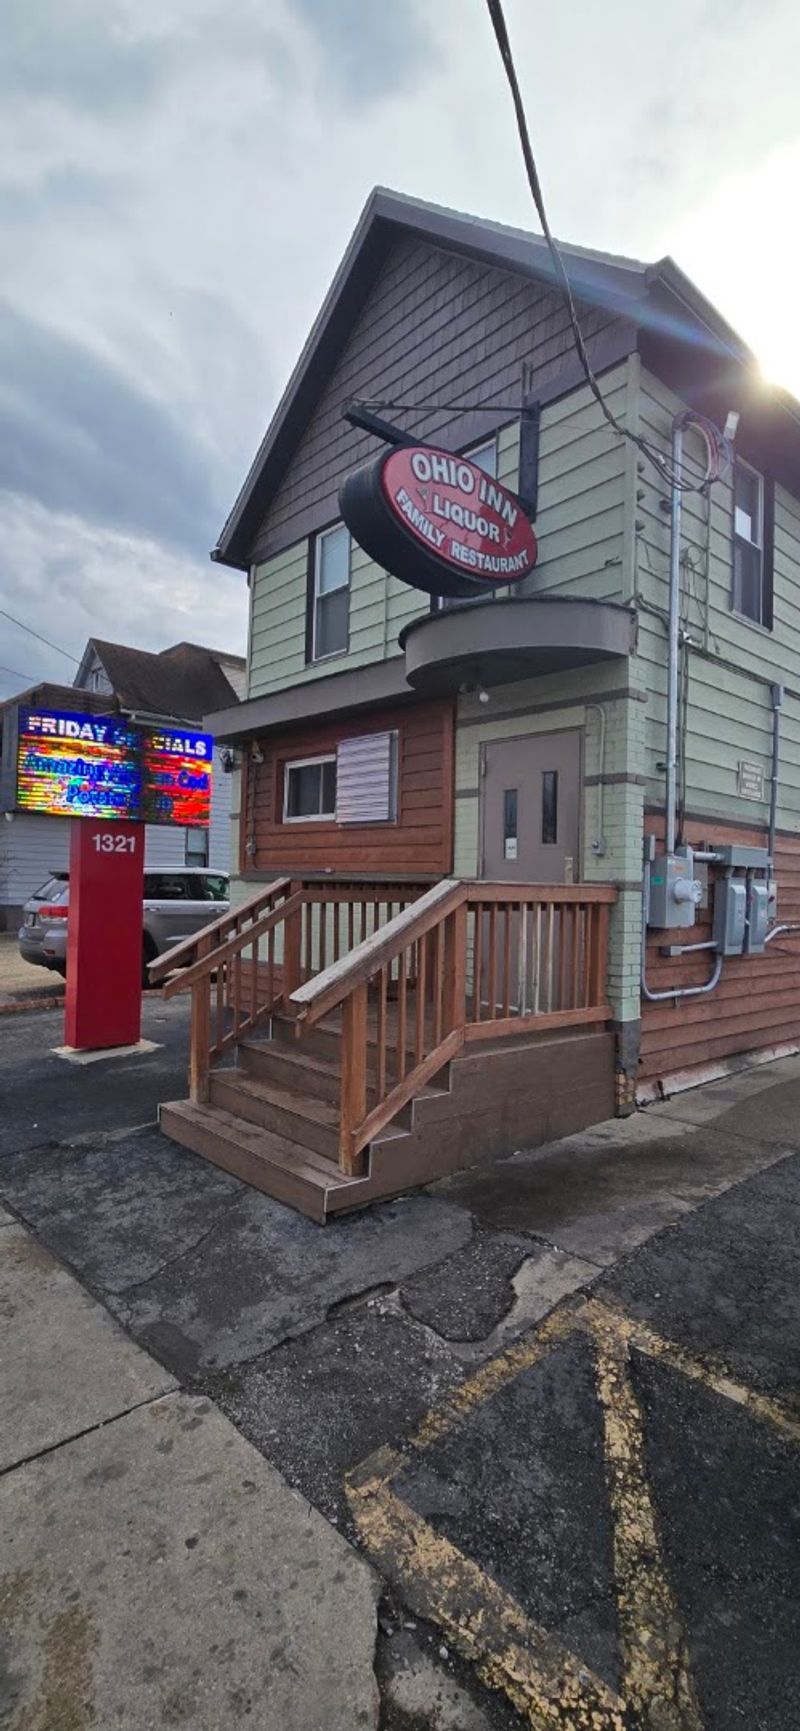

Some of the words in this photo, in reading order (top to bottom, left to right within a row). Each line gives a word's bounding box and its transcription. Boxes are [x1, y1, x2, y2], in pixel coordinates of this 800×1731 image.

[411, 453, 475, 494] OHIO
[479, 480, 518, 528] INN
[394, 488, 445, 547] FAMILY
[451, 540, 529, 573] RESTAURANT
[433, 494, 500, 543] LIQUOR
[28, 715, 107, 742] FRIDAY
[113, 728, 206, 756] SPCIALS
[92, 834, 135, 853] 1321
